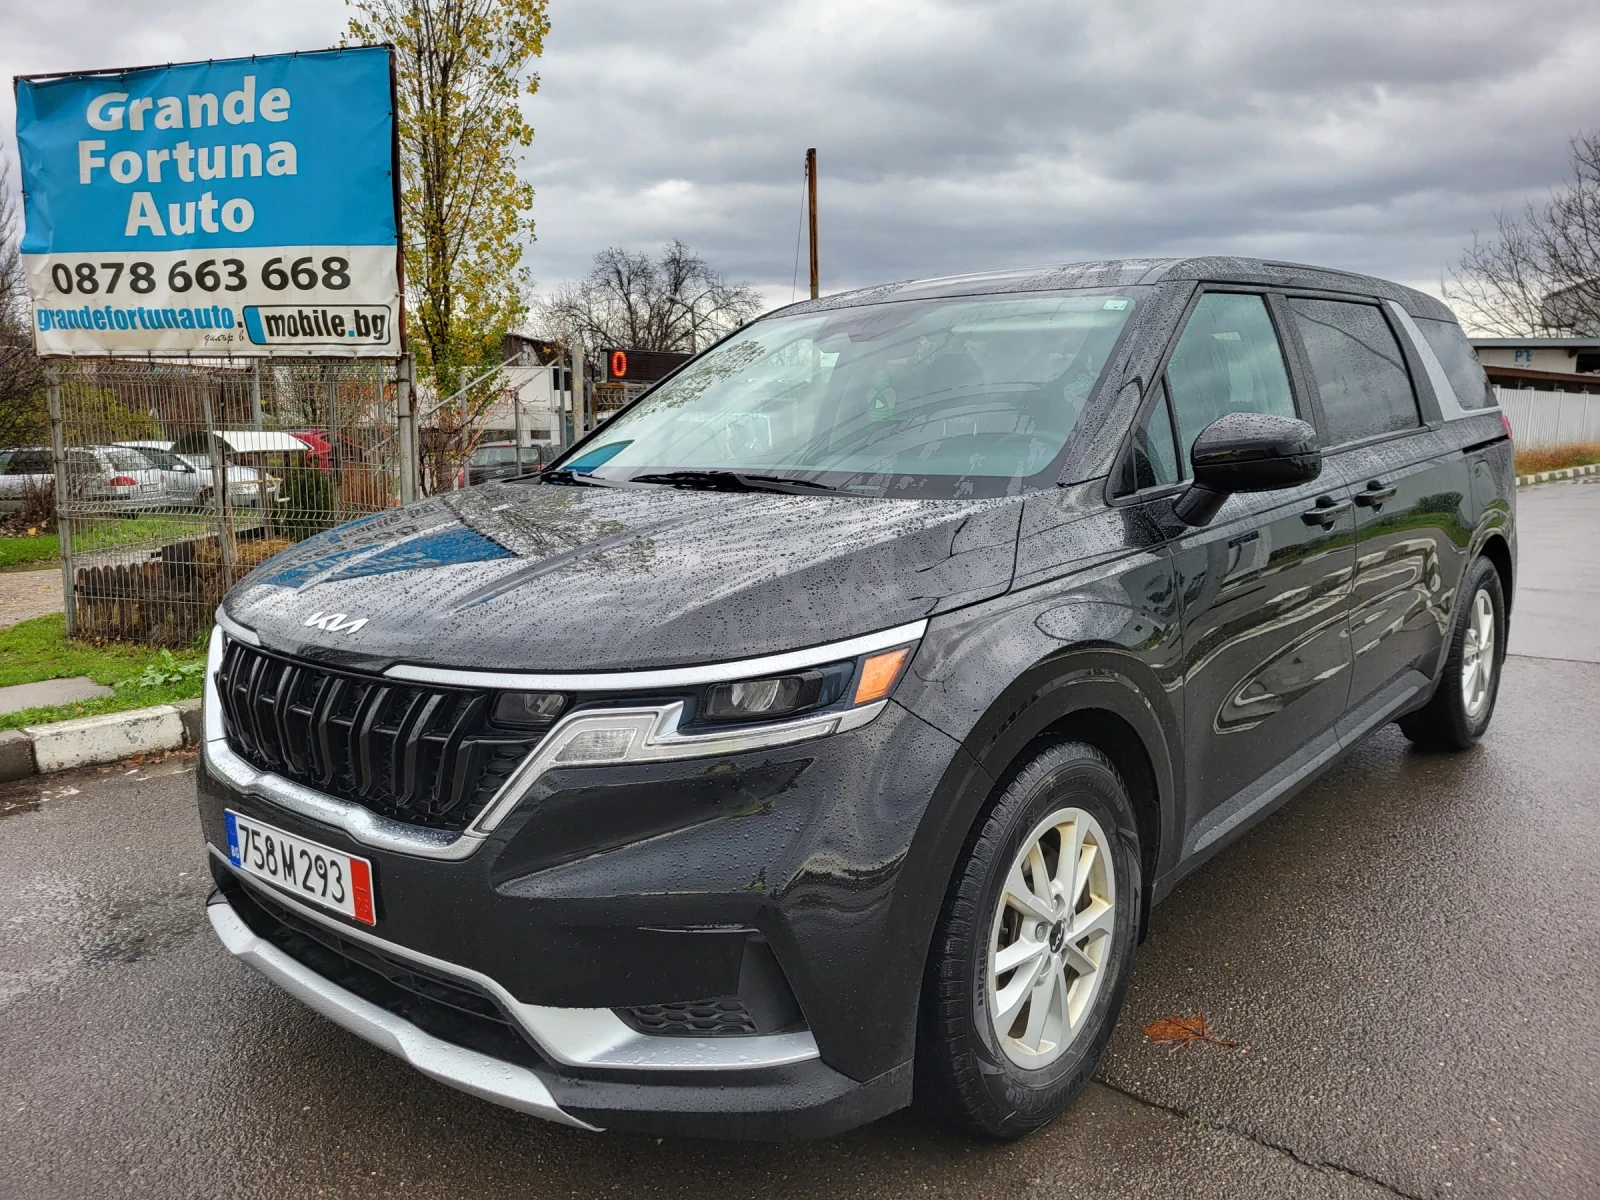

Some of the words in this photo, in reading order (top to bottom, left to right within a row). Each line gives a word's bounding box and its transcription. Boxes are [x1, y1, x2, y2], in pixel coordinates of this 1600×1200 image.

[86, 75, 291, 131] Grande
[78, 139, 298, 185] Fortuna
[124, 190, 255, 237] Auto
[51, 261, 156, 295] 0878
[168, 258, 248, 293] 663
[261, 255, 351, 291] 668
[266, 308, 385, 341] mobile.bg
[611, 350, 627, 377] 0
[303, 610, 370, 635] KIA
